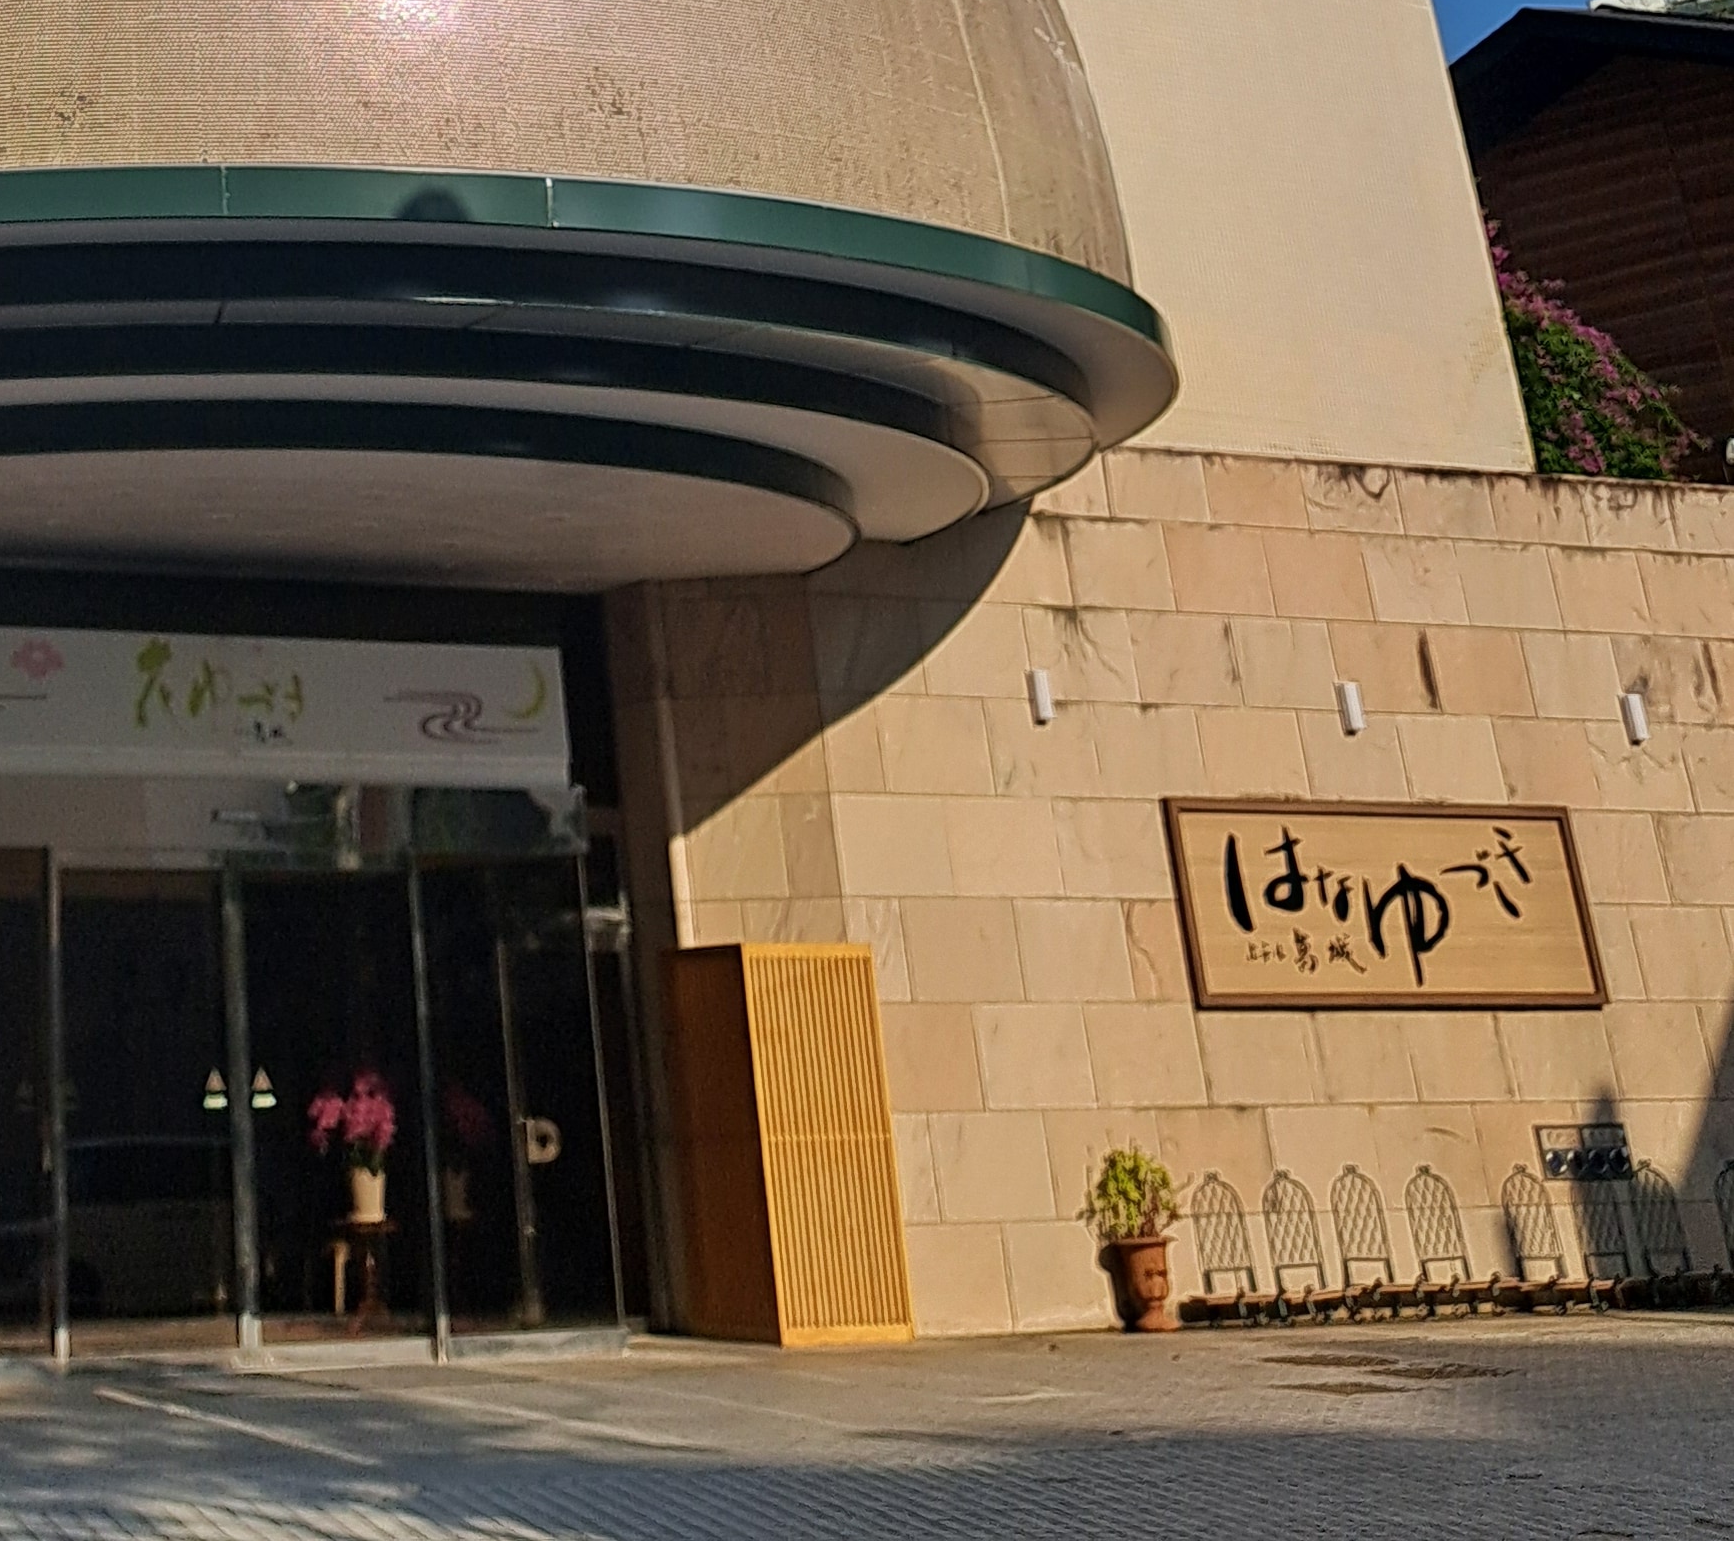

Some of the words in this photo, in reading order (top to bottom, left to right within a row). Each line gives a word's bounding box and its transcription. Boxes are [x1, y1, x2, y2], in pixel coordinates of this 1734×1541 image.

[1223, 824, 1532, 988] はなゆづき
